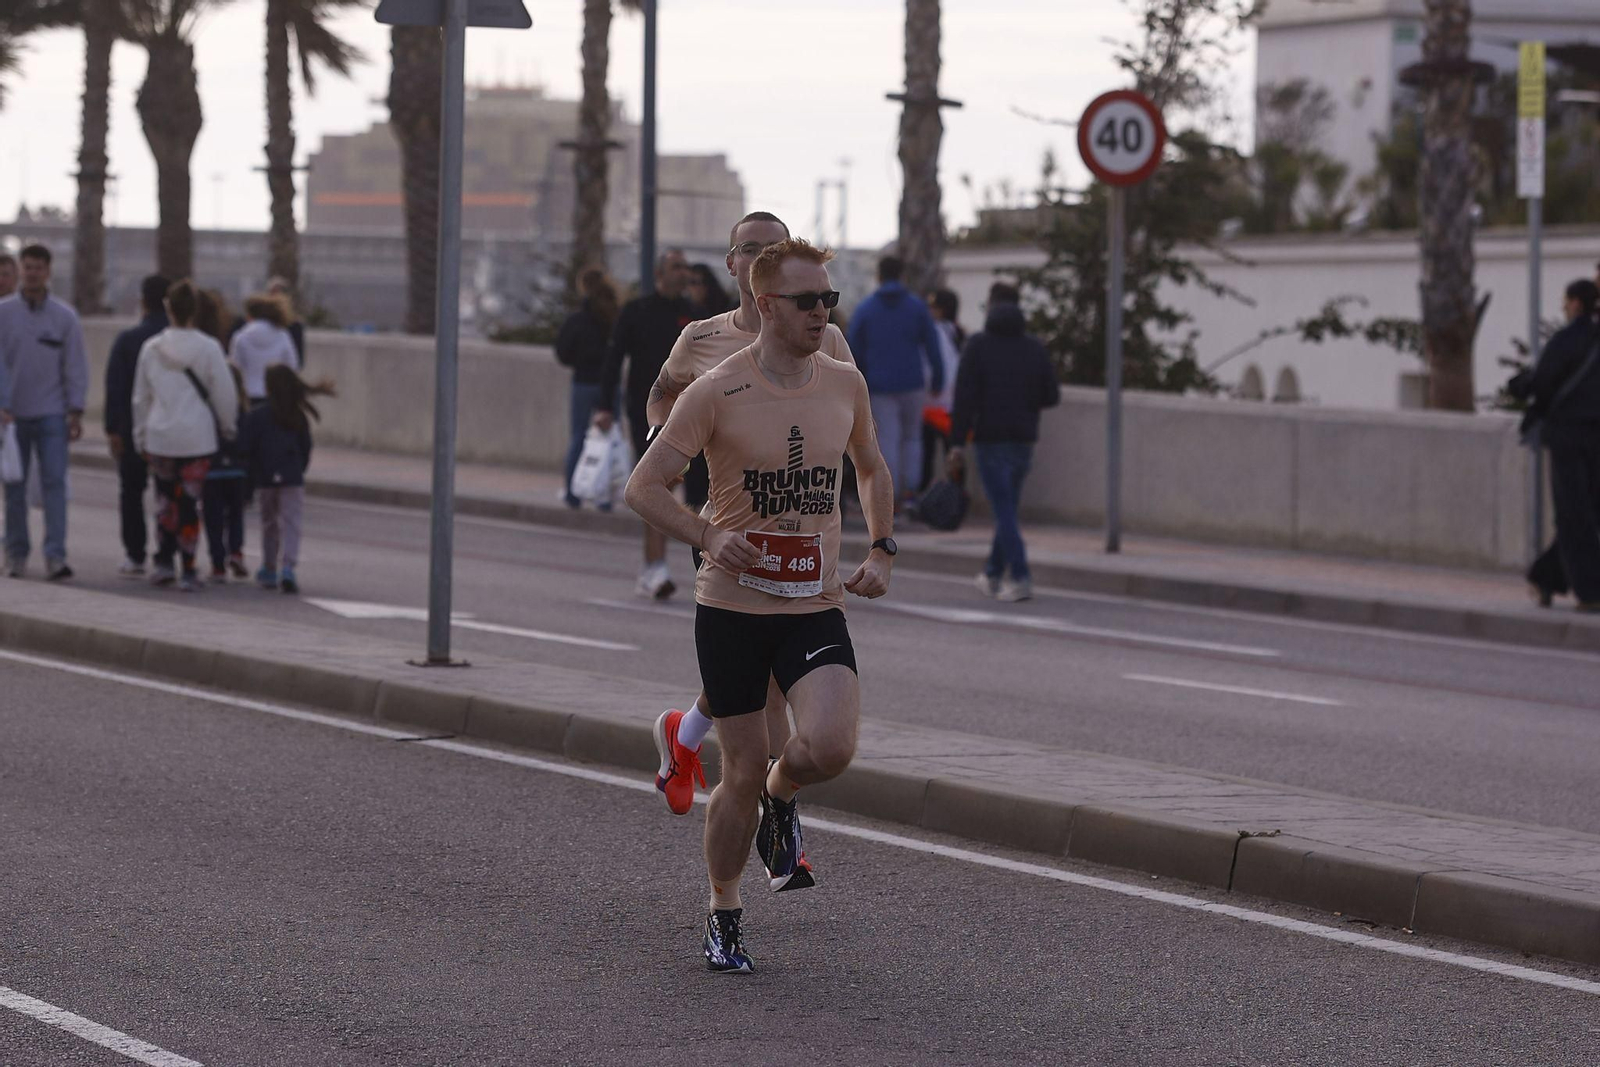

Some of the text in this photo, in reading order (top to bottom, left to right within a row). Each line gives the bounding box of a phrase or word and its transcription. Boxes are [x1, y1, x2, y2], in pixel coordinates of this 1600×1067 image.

[1097, 118, 1141, 153] 40
[693, 332, 713, 341] luanvi
[724, 386, 744, 396] luanvi
[742, 466, 837, 495] BRUNCH
[803, 489, 835, 502] MÁLAGA
[751, 489, 802, 519] RUN
[800, 501, 835, 515] 2025
[787, 556, 815, 572] 486
